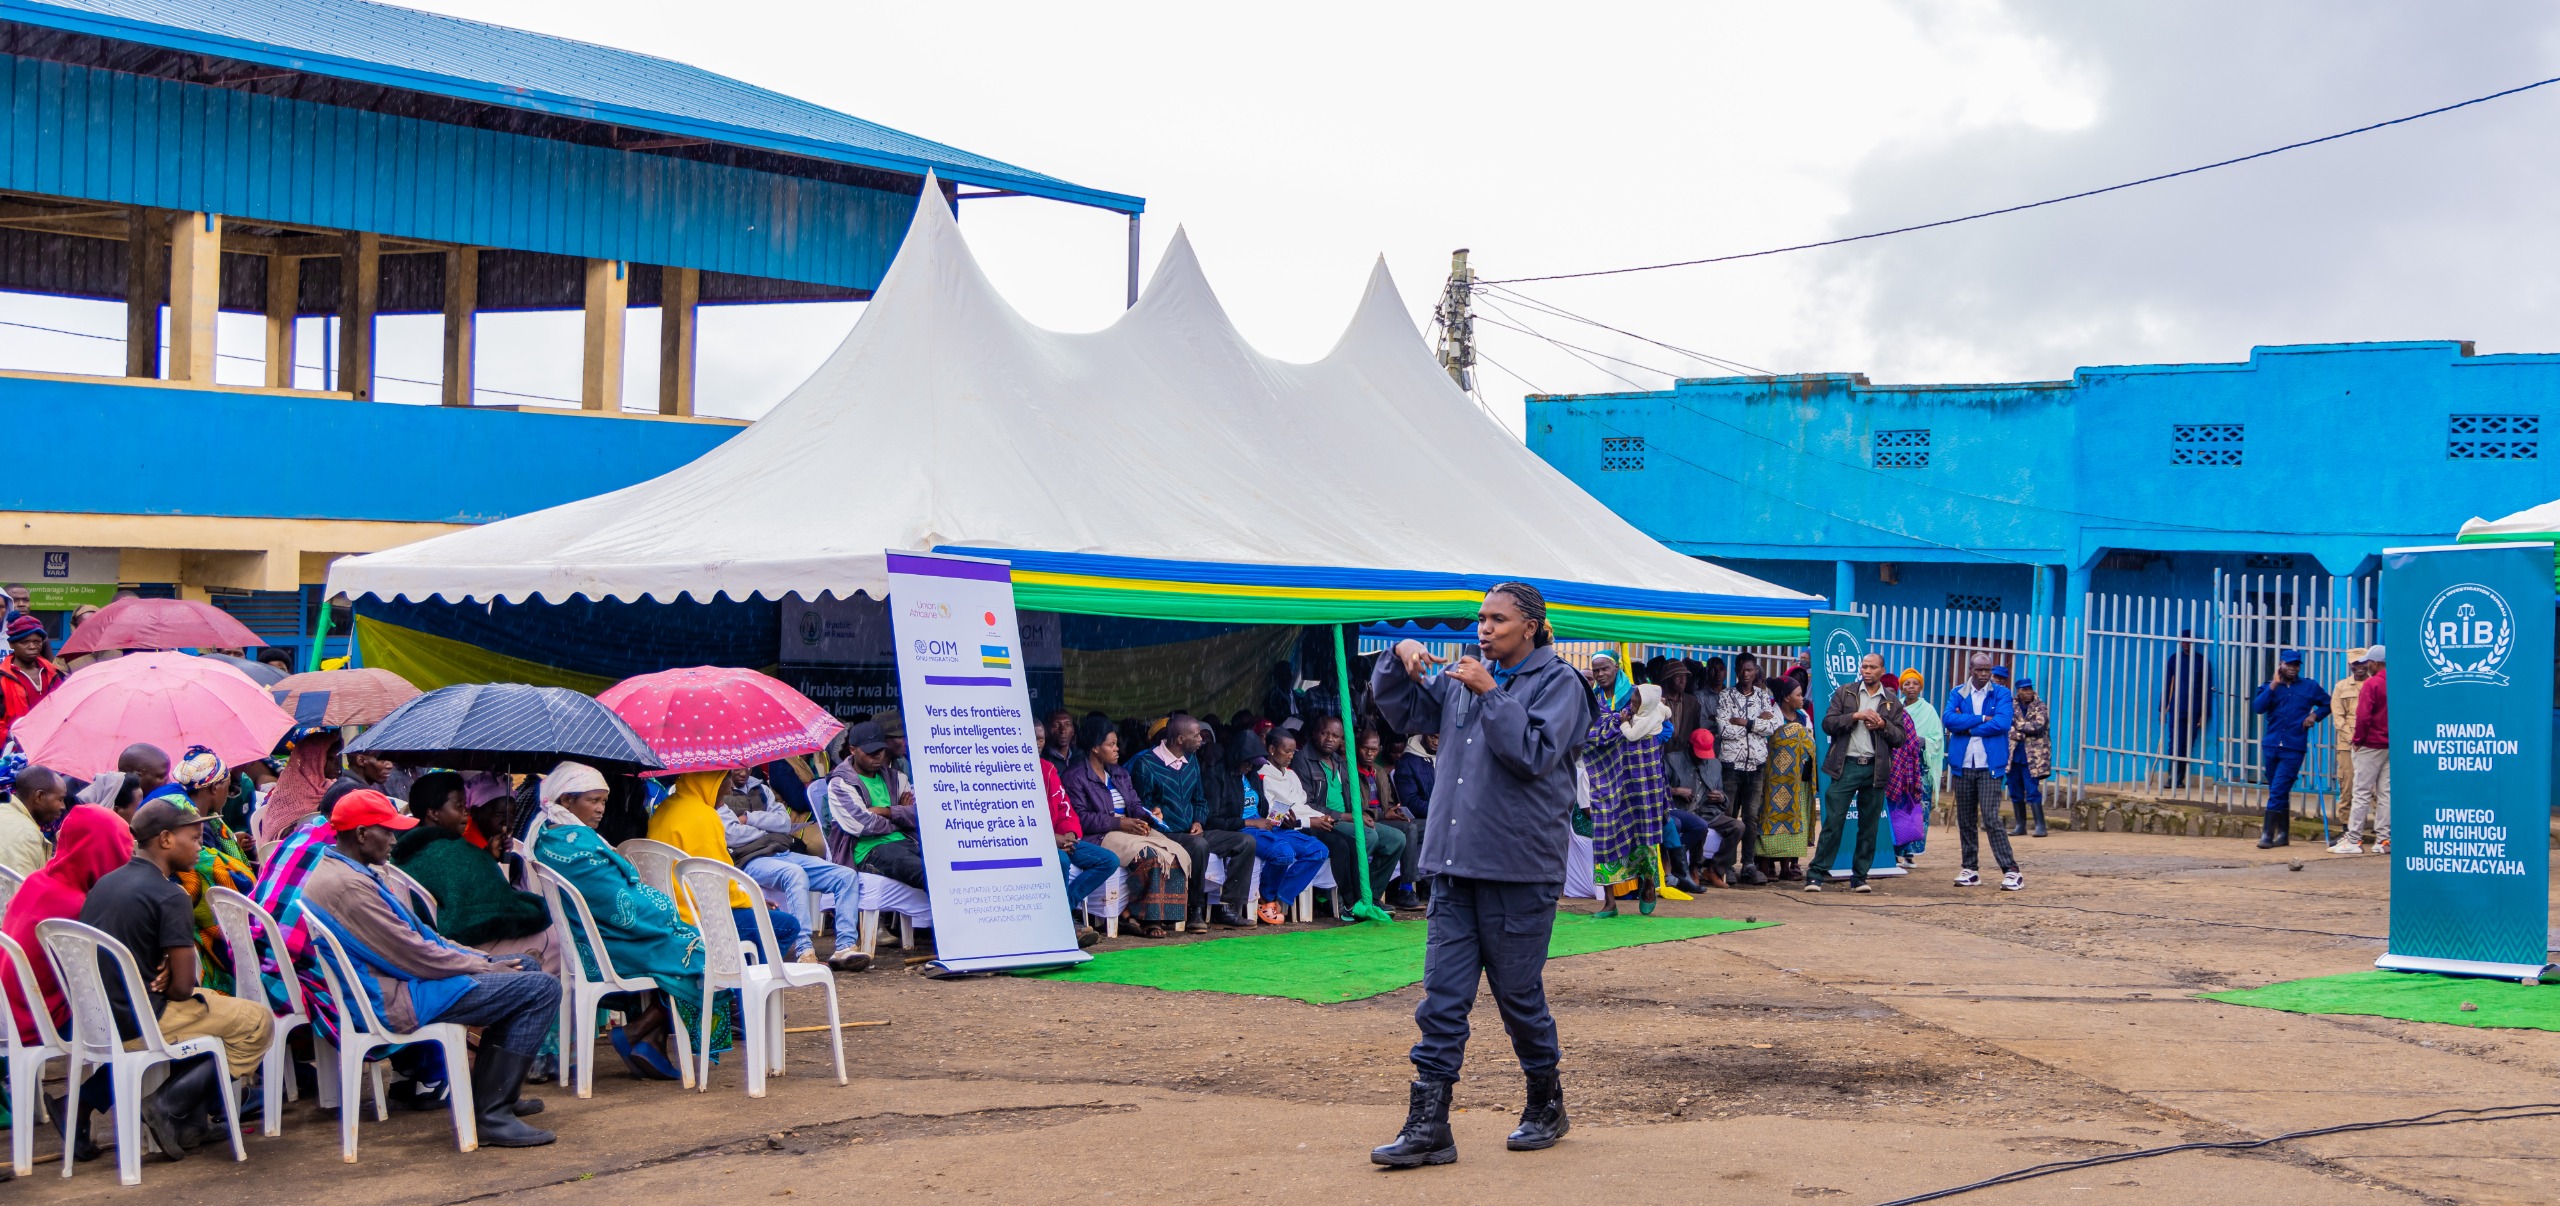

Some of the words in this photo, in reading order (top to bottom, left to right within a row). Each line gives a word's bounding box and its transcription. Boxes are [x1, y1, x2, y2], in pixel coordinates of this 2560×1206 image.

[2446, 586, 2491, 597] INVESTIGATION
[916, 600, 937, 610] Union
[1020, 625, 1044, 640] OM
[2440, 620, 2494, 645] RIB
[929, 640, 958, 656] OIM
[1831, 655, 1856, 673] RIB
[800, 681, 855, 697] Uruhare
[857, 684, 879, 697] rwa
[925, 705, 948, 717] Vers
[950, 706, 968, 717] des
[970, 706, 1021, 718] frontières
[931, 724, 951, 738] plus
[953, 724, 1016, 739] intelligentes
[2436, 723, 2496, 738] RWANDA
[924, 743, 972, 754] renforcer
[975, 743, 989, 754] les
[992, 743, 1019, 754] voies
[1021, 743, 1033, 754] de
[2413, 740, 2518, 755] INVESTIGATION
[929, 761, 972, 773] mobilité
[974, 761, 1021, 776] régulière
[1024, 762, 1034, 772] et
[2438, 757, 2493, 771] BUREAU
[933, 780, 958, 794] sûre,
[960, 780, 970, 791] la
[972, 778, 1037, 791] connectivité
[941, 801, 952, 811] et
[1021, 800, 1035, 809] en
[2435, 808, 2495, 823] URWEGO
[945, 818, 984, 833] Afrique
[987, 816, 1015, 832] grâce
[1018, 816, 1025, 827] à
[1027, 815, 1037, 827] la
[2423, 824, 2507, 841] RW'IGIHUGU
[957, 835, 1029, 849] numérisation
[2424, 841, 2506, 858] RUSHINZWE
[2406, 857, 2526, 875] UBUGENZACYAHA
[1002, 882, 1051, 892] GOUVERNEMENT
